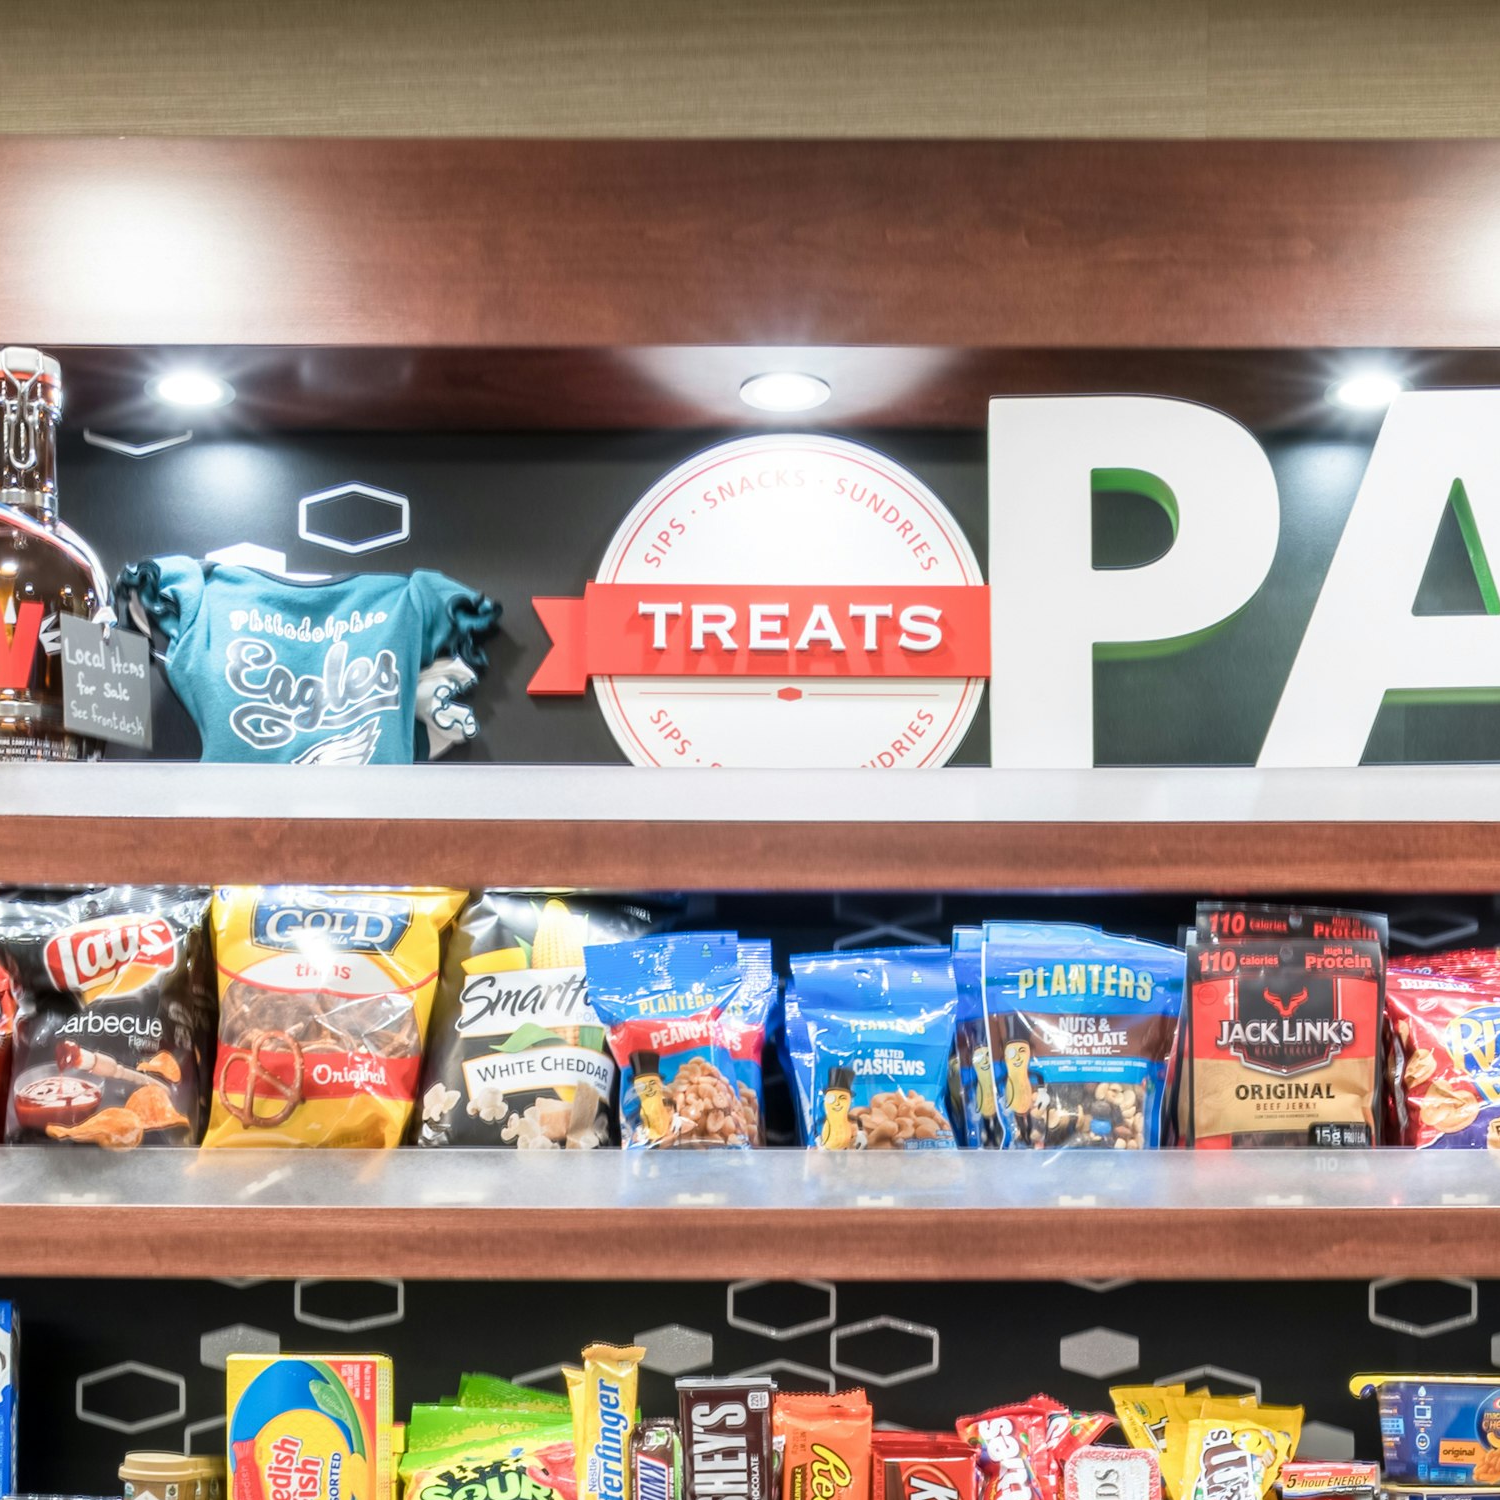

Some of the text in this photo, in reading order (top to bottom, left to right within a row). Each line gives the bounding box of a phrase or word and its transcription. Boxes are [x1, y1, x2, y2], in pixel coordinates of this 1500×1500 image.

[643, 468, 940, 572] SIPS SNACKS SUNDRIES
[228, 608, 389, 643] Philadelphia
[637, 600, 944, 653] TREATS
[64, 637, 146, 679] Local items
[77, 671, 130, 702] for Sale
[225, 637, 401, 735] Eagles
[70, 700, 89, 720] See
[648, 707, 693, 757] SIPS
[265, 909, 394, 945] GOLD
[1209, 911, 1246, 934] 110
[1313, 922, 1379, 941] Protein
[1323, 945, 1343, 956] High
[1198, 951, 1279, 973] 110 calories
[1304, 954, 1373, 969] Protein
[1017, 963, 1154, 1003] PLANTERS
[1058, 1017, 1111, 1034] NUTS &
[1216, 1019, 1355, 1047] JACK LINK'S
[873, 1048, 905, 1060] SALTED
[1091, 1046, 1113, 1055] MIX
[476, 1055, 609, 1083] WHITE CHEDDAR
[851, 1058, 926, 1077] CASHEWS
[1235, 1083, 1336, 1101] ORIGINAL
[1255, 1102, 1318, 1111] BEEF JERKY
[1315, 1128, 1341, 1147] 15g
[1442, 1447, 1476, 1458] original
[1286, 1473, 1370, 1489] 5-hour ENERGY
